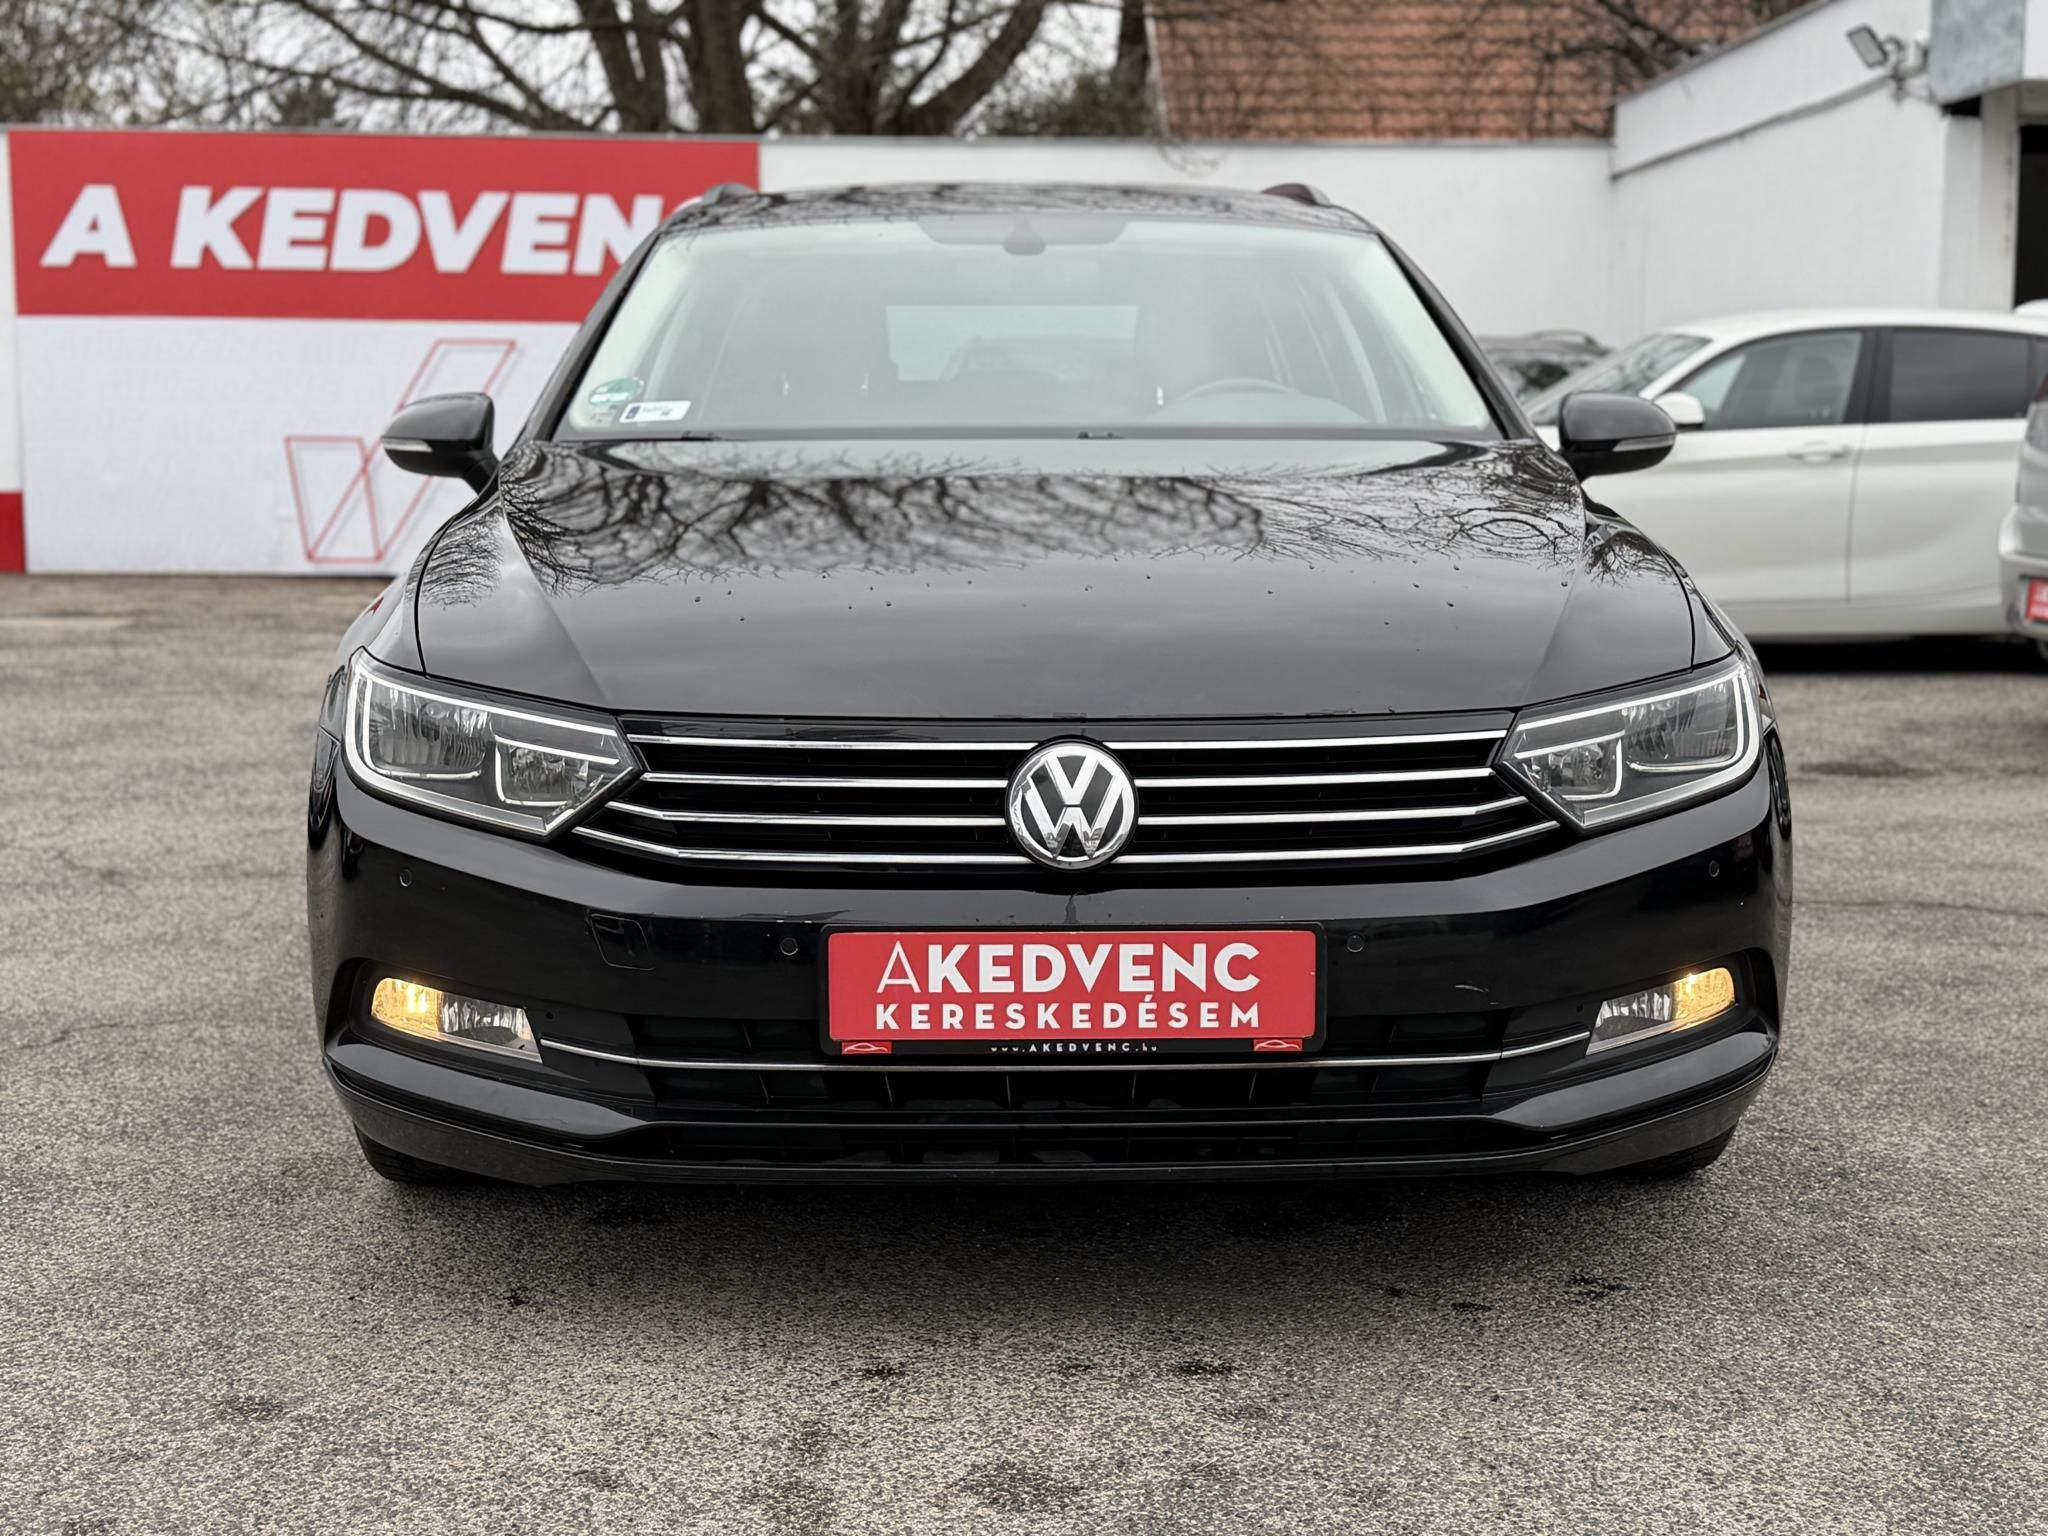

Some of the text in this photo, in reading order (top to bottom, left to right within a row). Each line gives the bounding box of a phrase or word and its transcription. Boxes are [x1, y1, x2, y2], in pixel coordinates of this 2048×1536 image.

[40, 184, 702, 276] A KEDVEN
[875, 993, 1260, 1031] KERESKEDÉSEM
